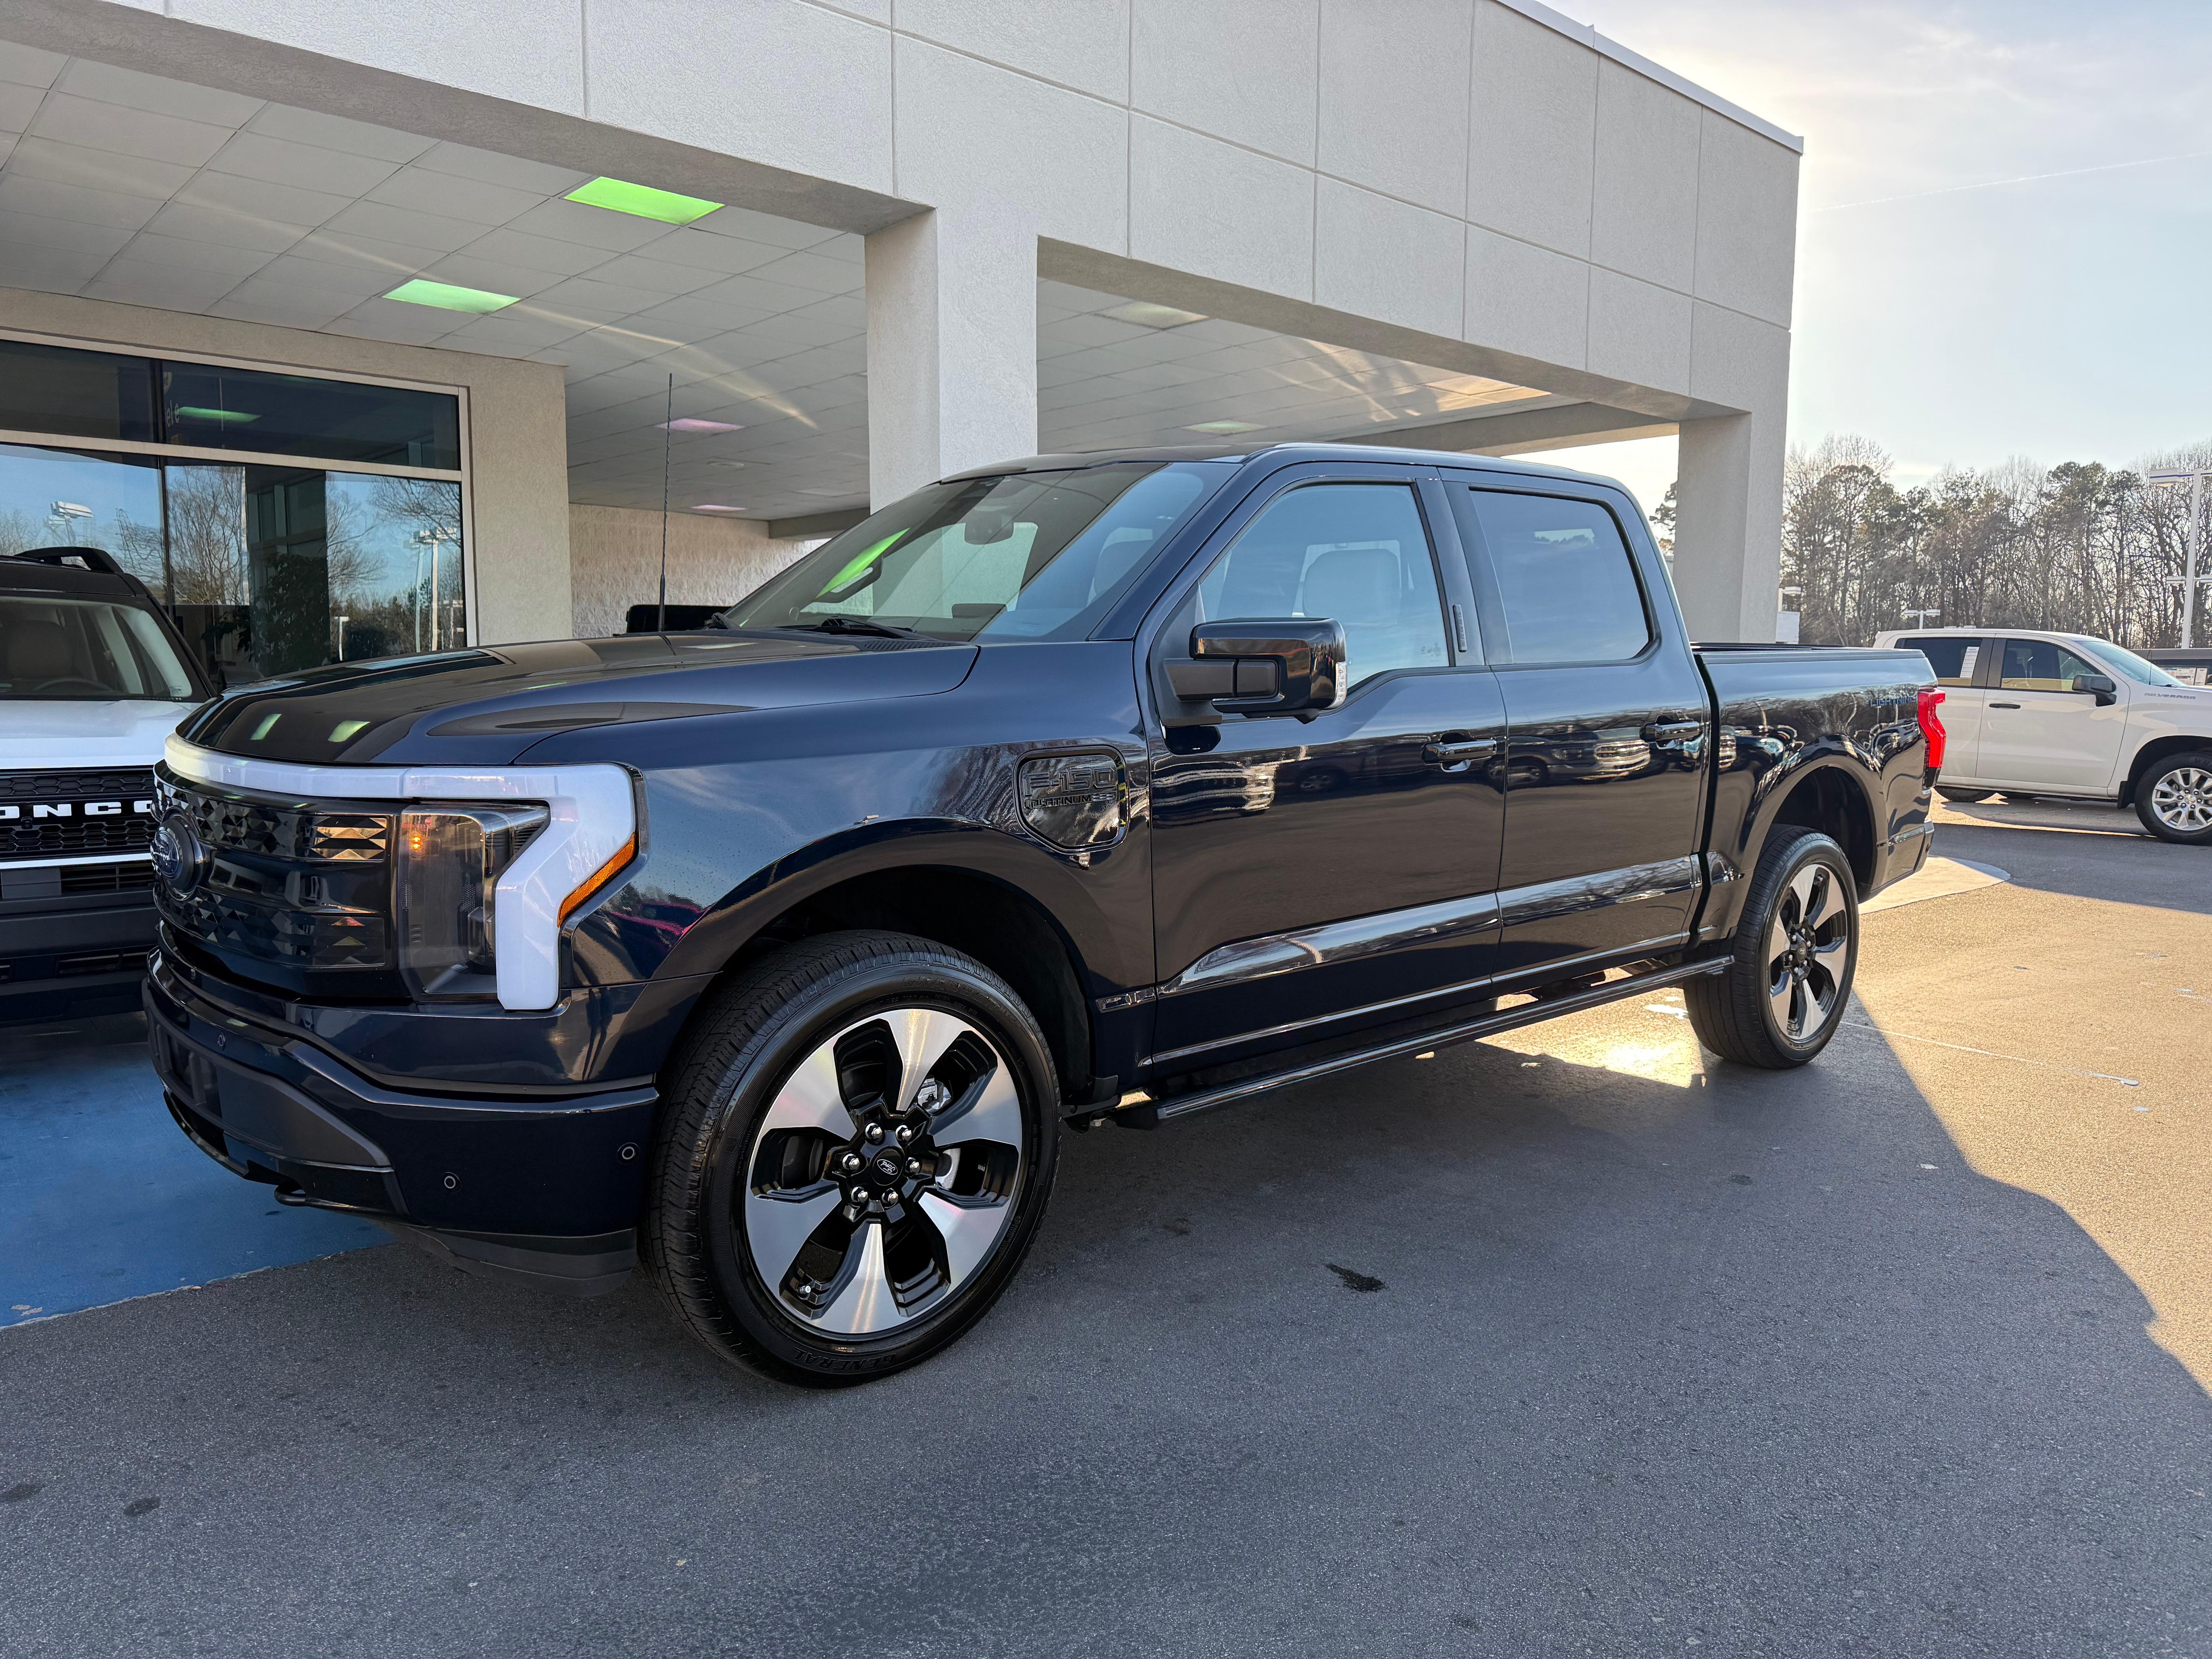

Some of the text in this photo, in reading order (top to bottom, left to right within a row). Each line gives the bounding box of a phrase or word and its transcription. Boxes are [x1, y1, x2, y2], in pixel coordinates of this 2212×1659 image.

[1022, 766, 1116, 796] F-150
[1030, 794, 1092, 809] PLATINUM
[879, 1160, 896, 1173] Ford
[794, 1347, 896, 1371] GENERAL
